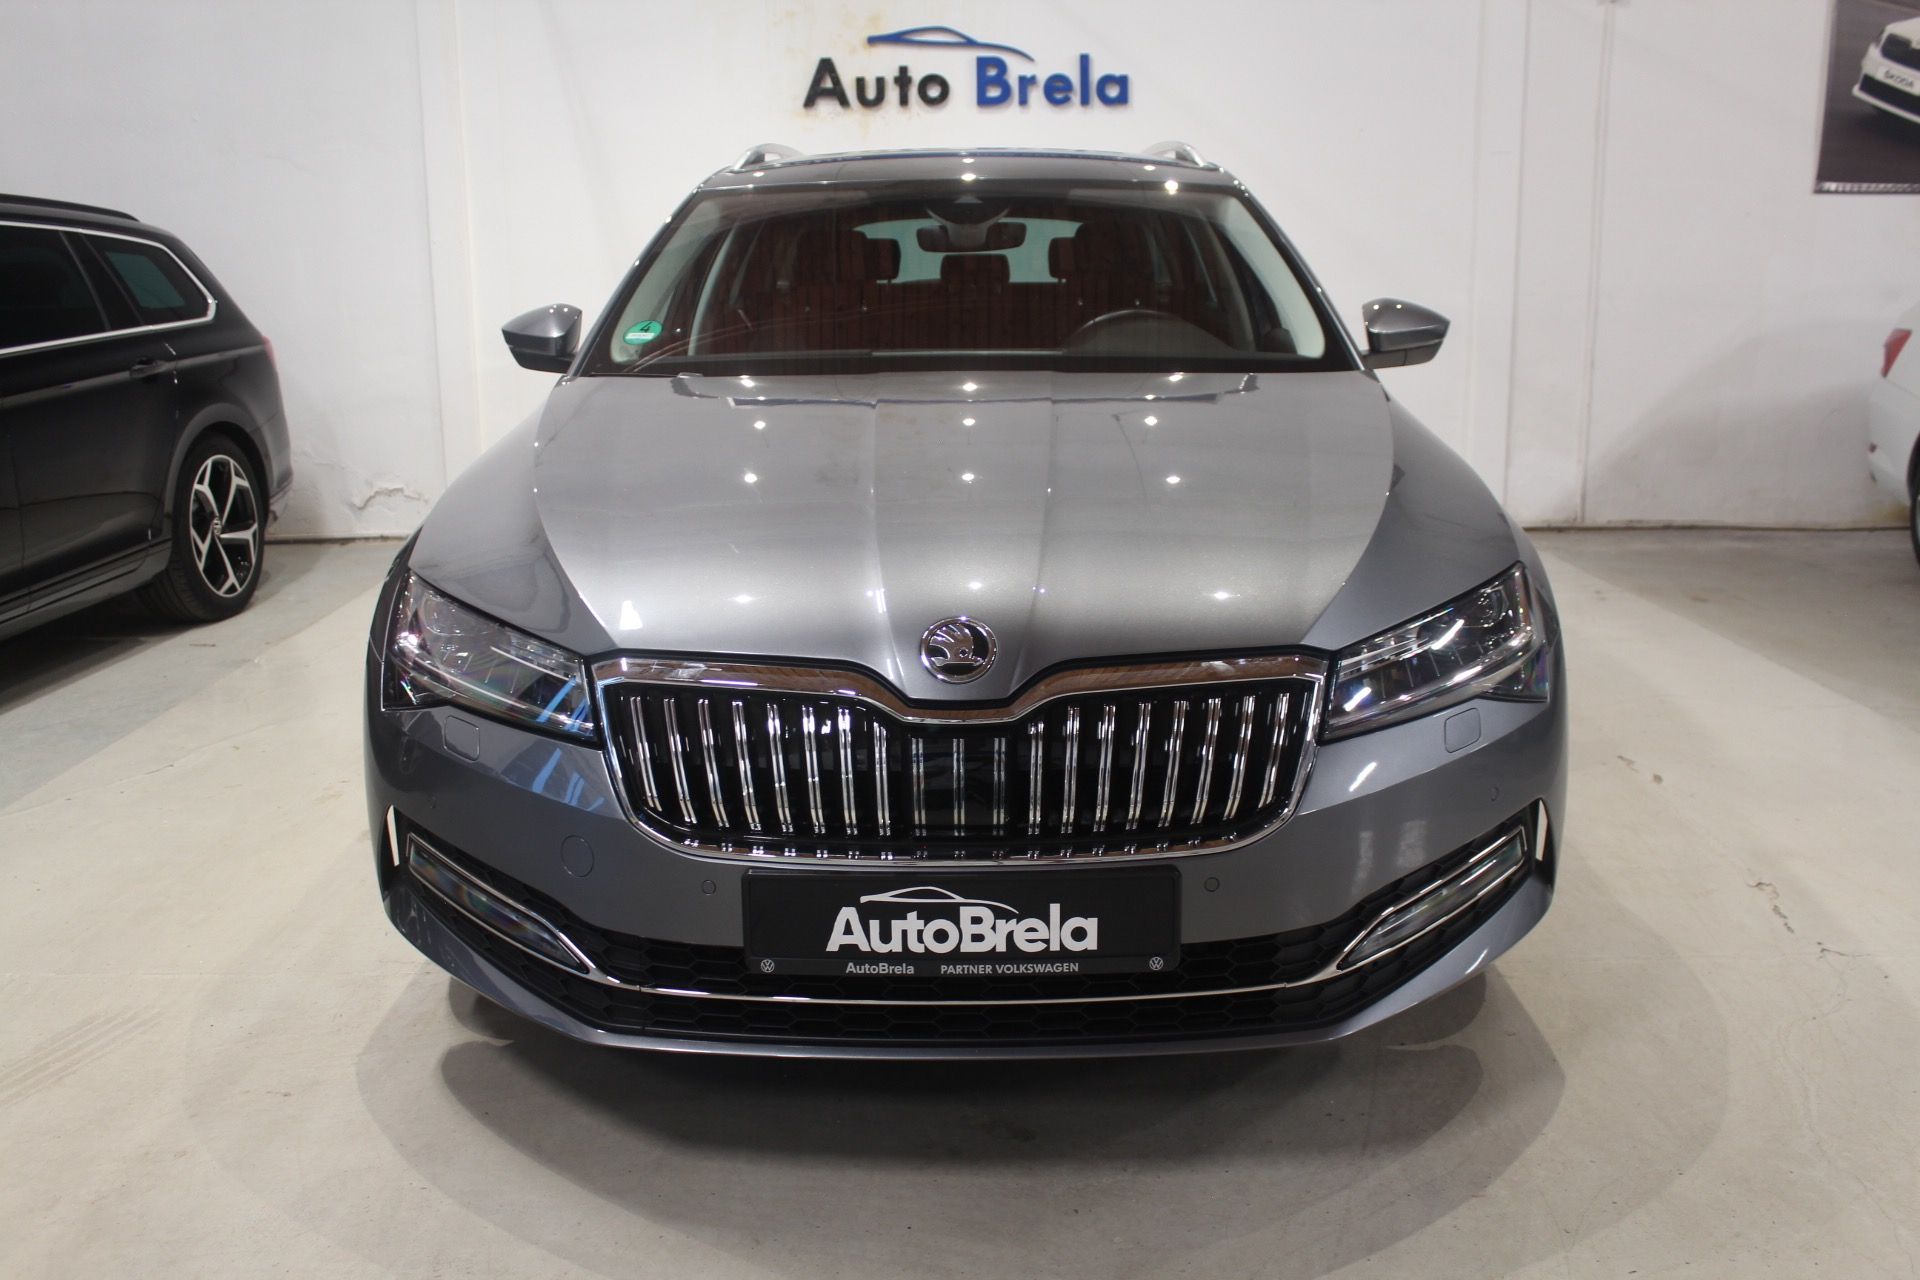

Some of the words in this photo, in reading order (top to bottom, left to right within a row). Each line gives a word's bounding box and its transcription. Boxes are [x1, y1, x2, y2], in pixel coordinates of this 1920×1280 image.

[803, 57, 951, 109] Auto
[976, 53, 1129, 107] Brela
[826, 903, 1098, 953] AutoBrela
[845, 962, 915, 975] AutoBrela
[940, 964, 993, 975] PARTNER
[995, 962, 1079, 974] VOLKSWAGEN
